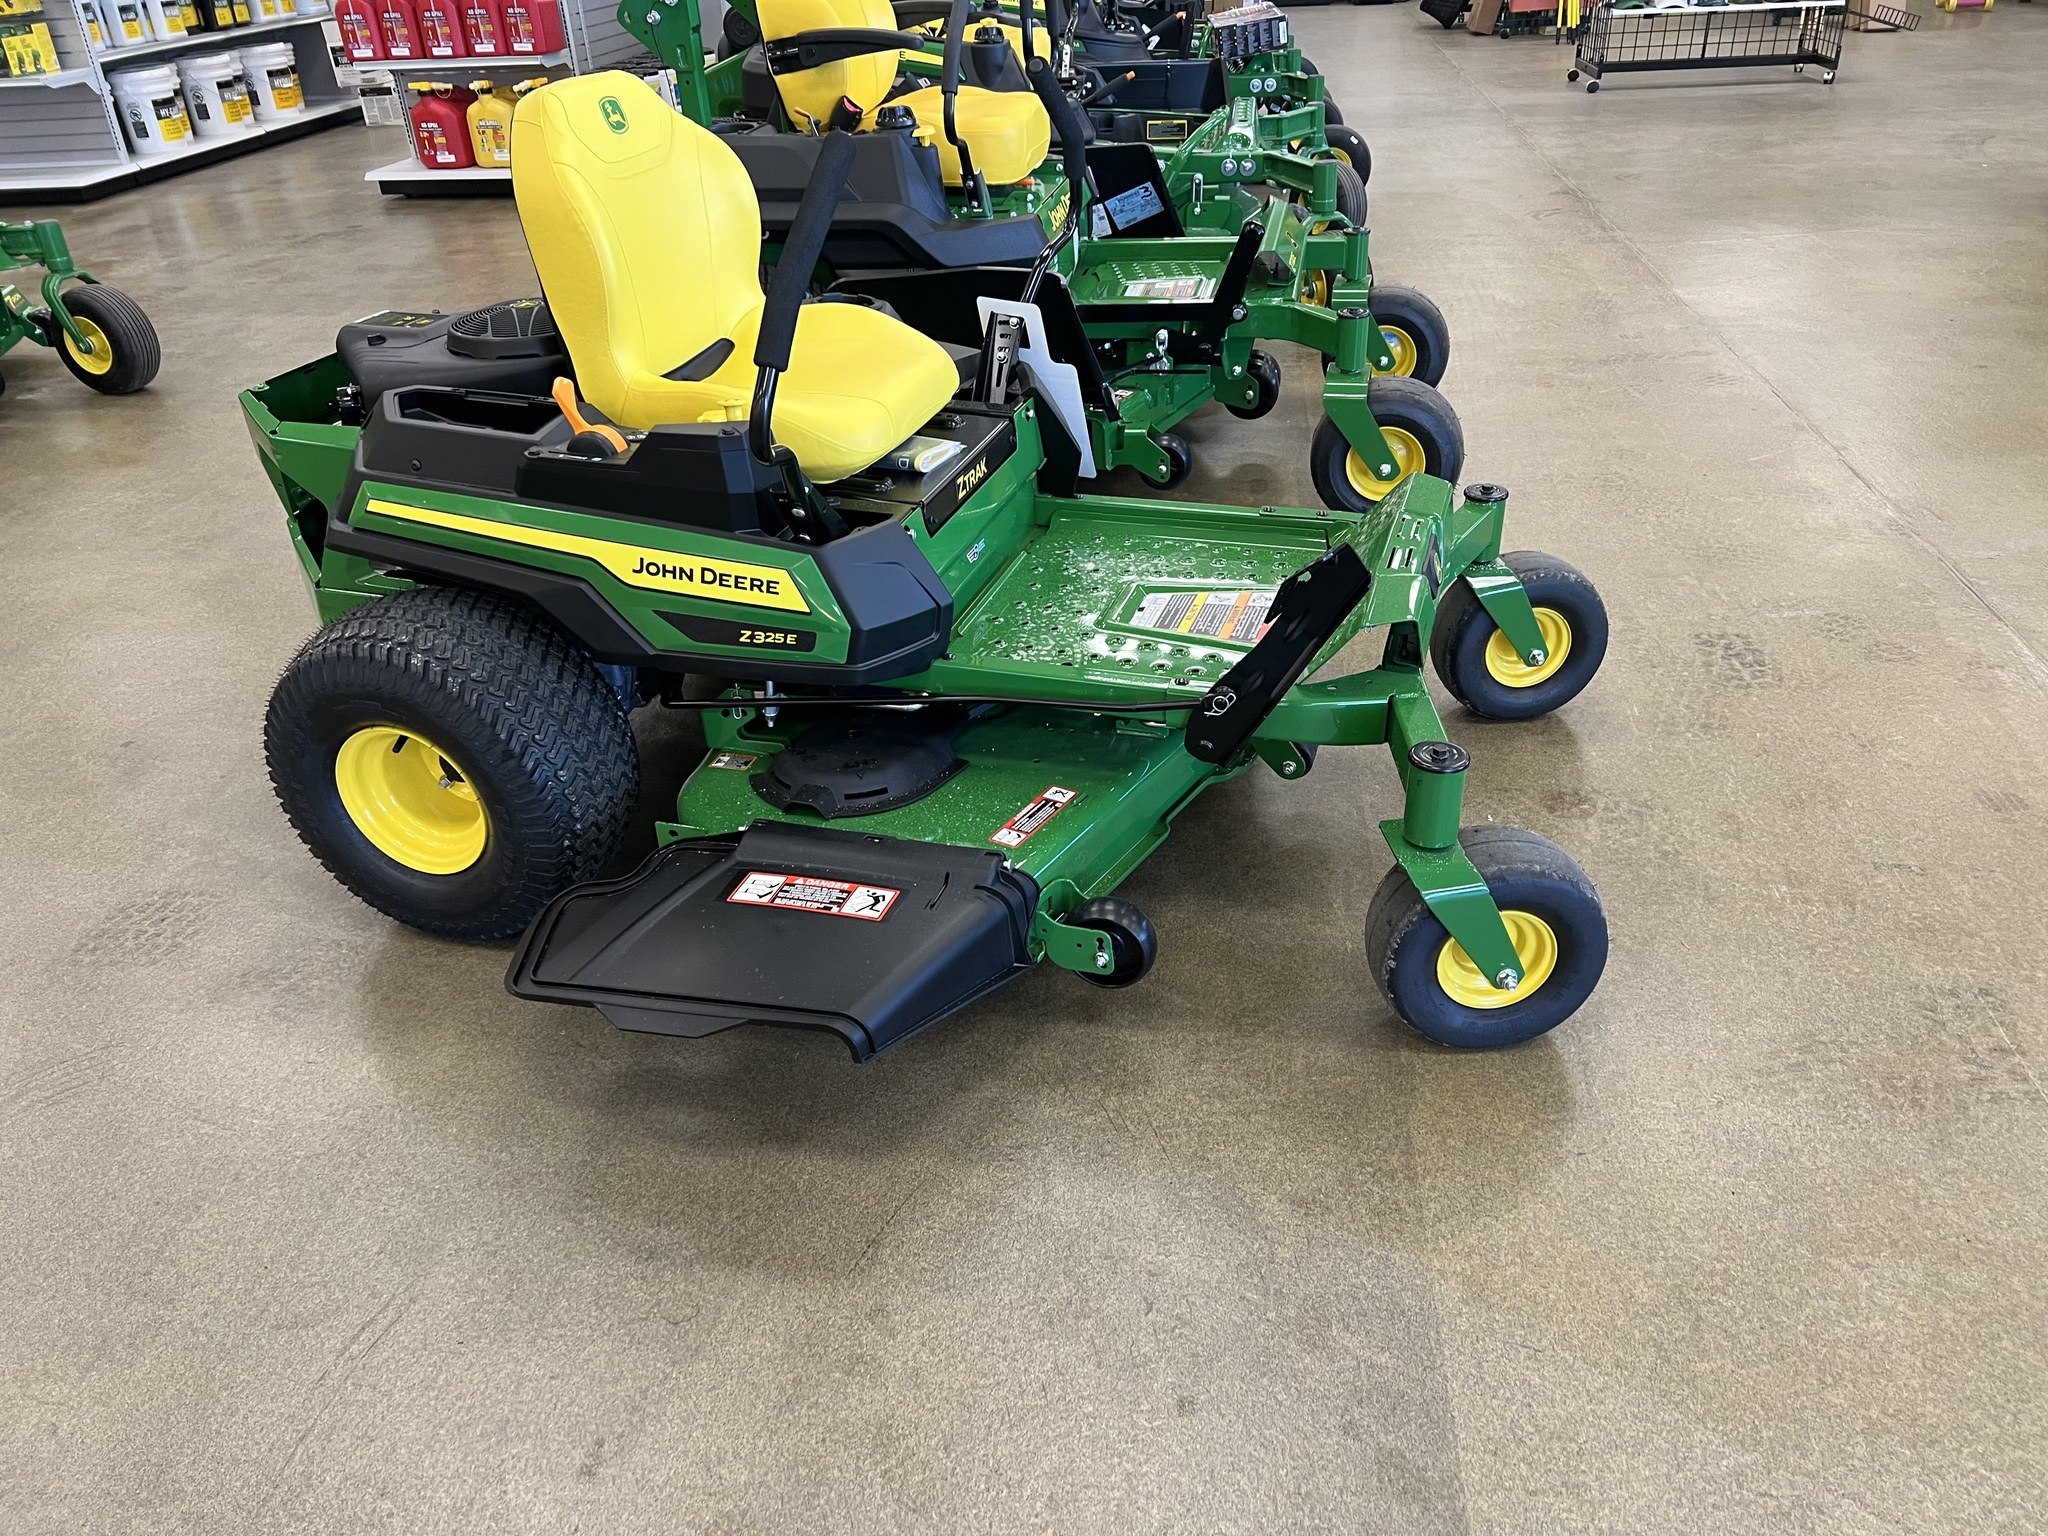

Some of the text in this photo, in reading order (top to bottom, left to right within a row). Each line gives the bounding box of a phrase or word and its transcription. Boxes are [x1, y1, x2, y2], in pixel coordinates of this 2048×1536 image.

[957, 457, 988, 500] ZTRAK
[632, 557, 780, 595] JOHN DEERE
[805, 878, 851, 890] DANGER
